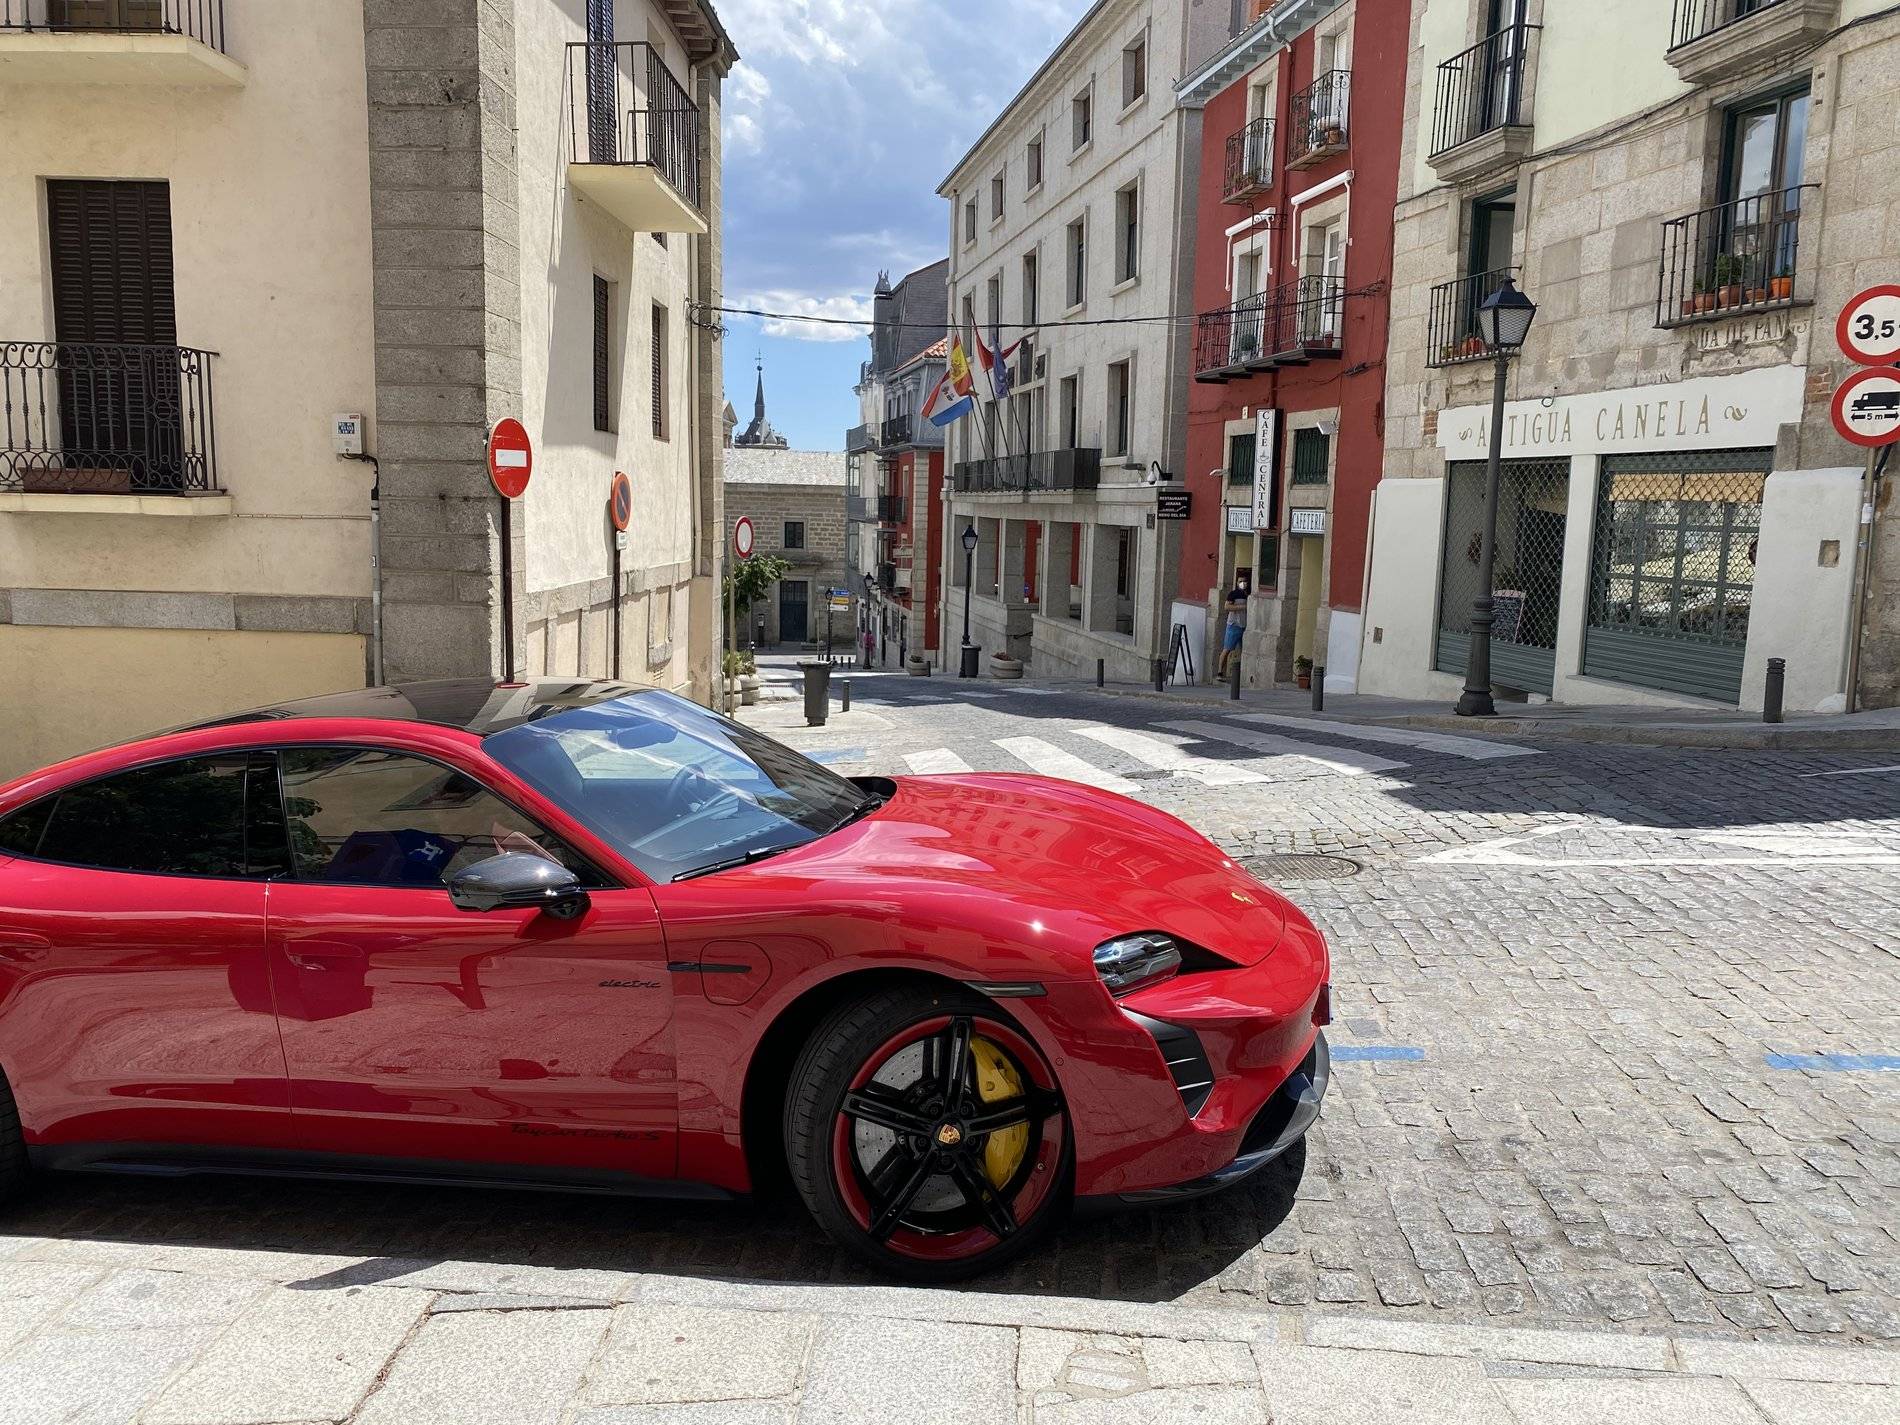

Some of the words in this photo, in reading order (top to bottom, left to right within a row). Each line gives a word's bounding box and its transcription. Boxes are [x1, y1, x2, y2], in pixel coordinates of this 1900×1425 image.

[1855, 314, 1895, 341] 3,5
[1261, 411, 1270, 447] CAFE
[1477, 407, 1571, 447] ATIGUA
[1596, 394, 1710, 441] CANELA
[1866, 413, 1873, 421] 5
[1874, 413, 1883, 421] m
[1257, 465, 1268, 527] CENTRAL
